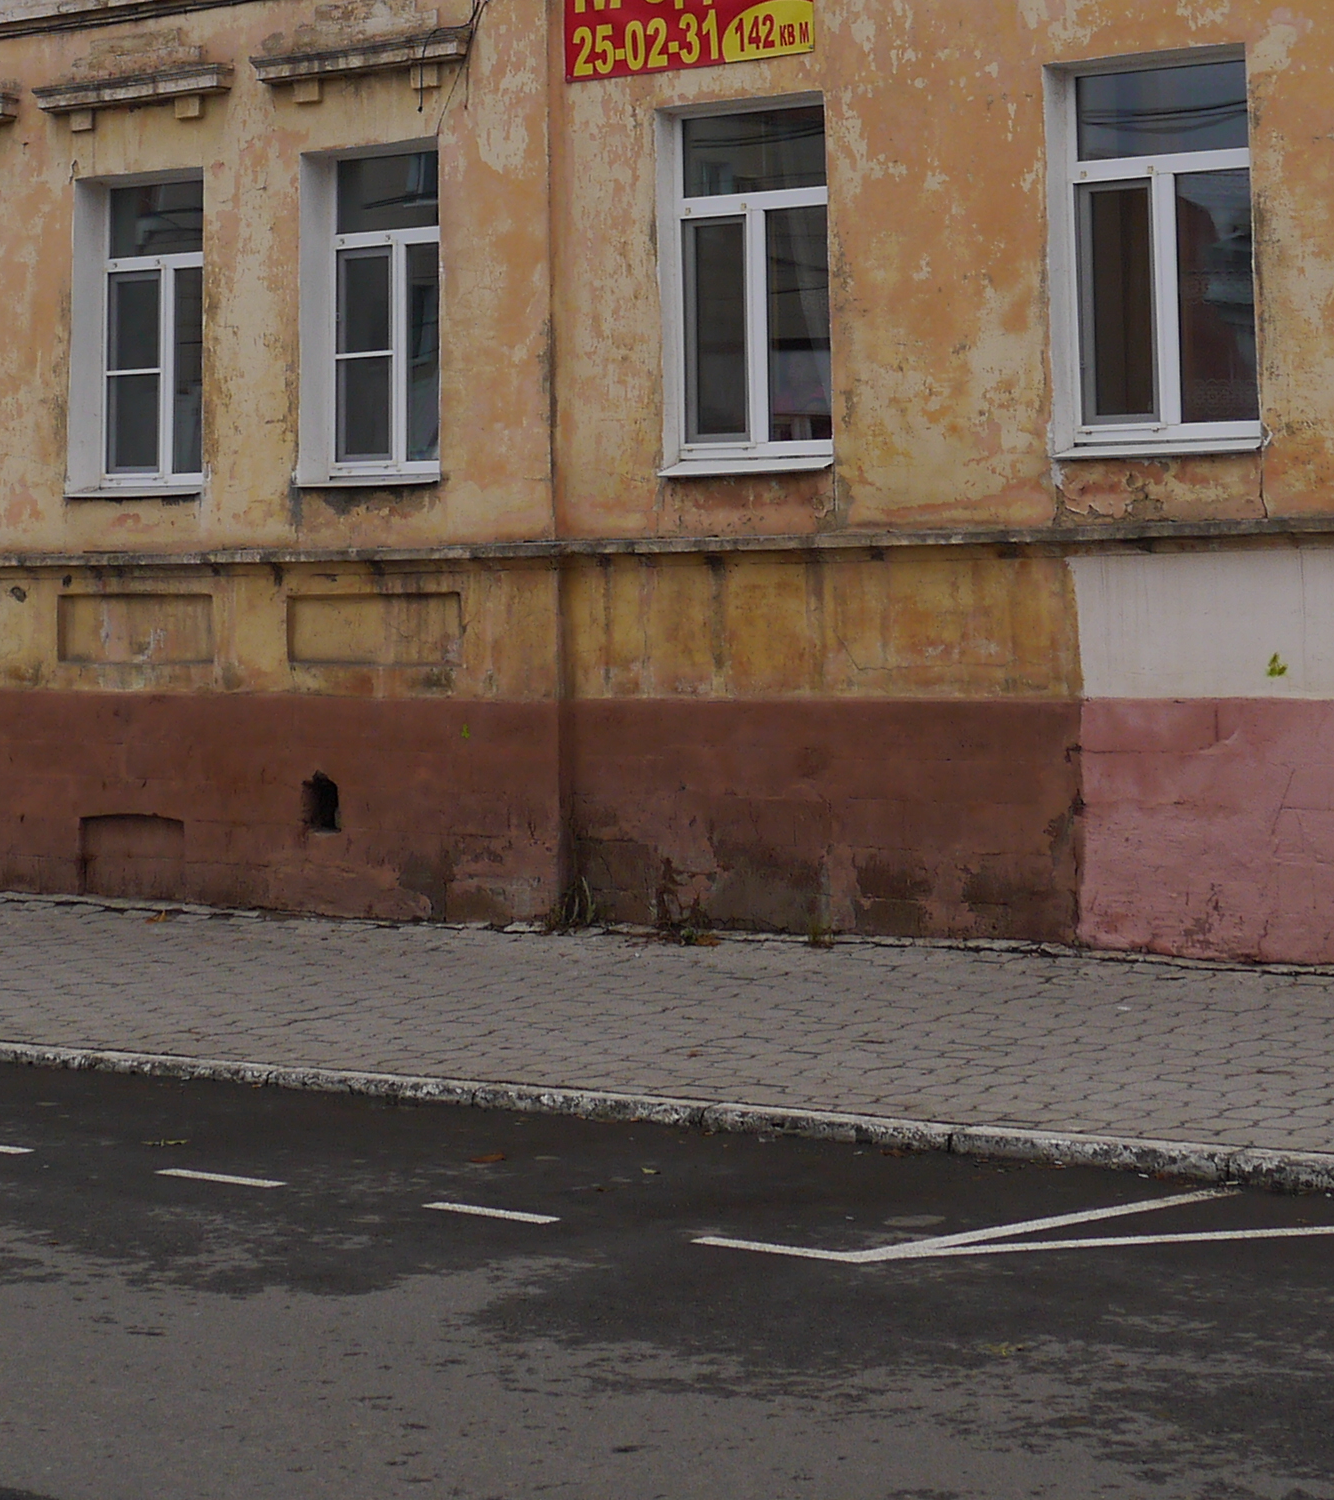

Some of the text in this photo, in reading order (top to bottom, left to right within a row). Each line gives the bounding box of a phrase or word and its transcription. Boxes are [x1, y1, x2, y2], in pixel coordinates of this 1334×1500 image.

[573, 9, 720, 77] 25-02-31
[734, 13, 810, 53] 142 КВ М
